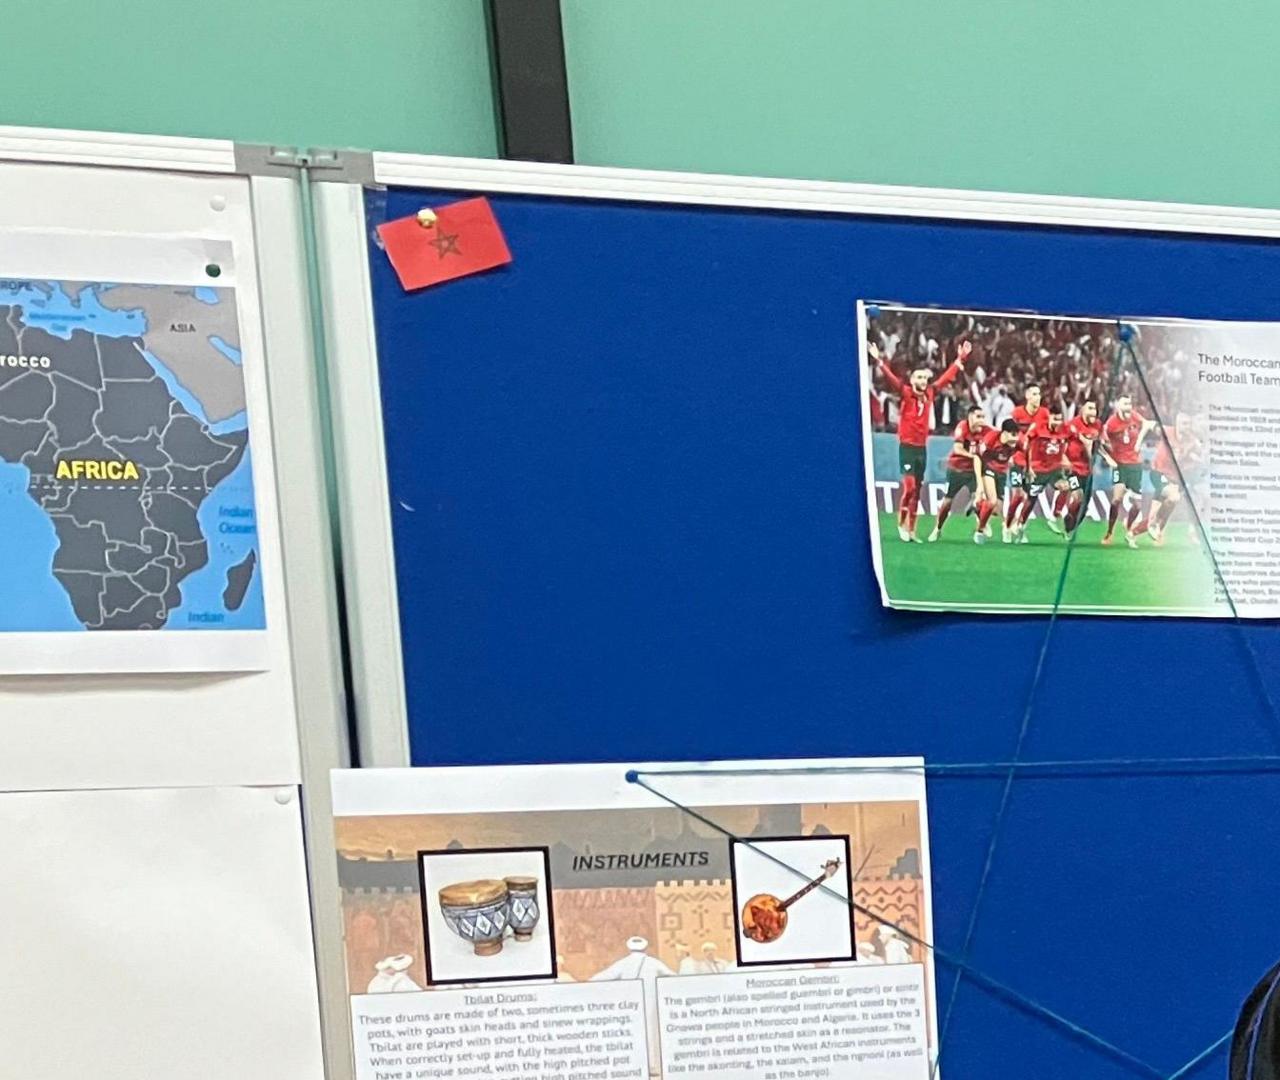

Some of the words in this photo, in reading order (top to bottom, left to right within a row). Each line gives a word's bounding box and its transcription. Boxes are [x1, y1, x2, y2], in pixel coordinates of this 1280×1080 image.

[170, 323, 197, 333] ASIA
[1198, 353, 1220, 366] The
[1198, 371, 1247, 384] Football
[1250, 373, 1280, 387] Team
[56, 460, 139, 480] AFRICA
[572, 851, 709, 871] INSTRUMENTS
[358, 1012, 392, 1026] These
[394, 1012, 430, 1023] drums
[432, 1011, 451, 1021] are
[453, 1009, 484, 1020] made
[486, 1006, 499, 1018] of
[587, 1001, 615, 1012] three
[396, 1025, 422, 1037] with
[484, 1020, 516, 1032] heads
[519, 1019, 539, 1030] and
[405, 1041, 423, 1051] are
[426, 1038, 463, 1051] played
[466, 1036, 491, 1047] with
[526, 1032, 553, 1043] thick
[556, 1030, 598, 1041] wooden
[369, 1055, 402, 1067] When
[405, 1053, 453, 1065] correctly
[493, 1049, 514, 1059] and
[516, 1046, 541, 1059] fully
[585, 1042, 602, 1053] the
[375, 1069, 402, 1080] have
[415, 1067, 454, 1079] unique
[495, 1062, 519, 1073] with
[522, 1060, 540, 1071] the
[543, 1058, 567, 1072] high
[570, 1055, 610, 1068] pitched
[612, 1055, 629, 1067] pot
[610, 1068, 641, 1079] sound
